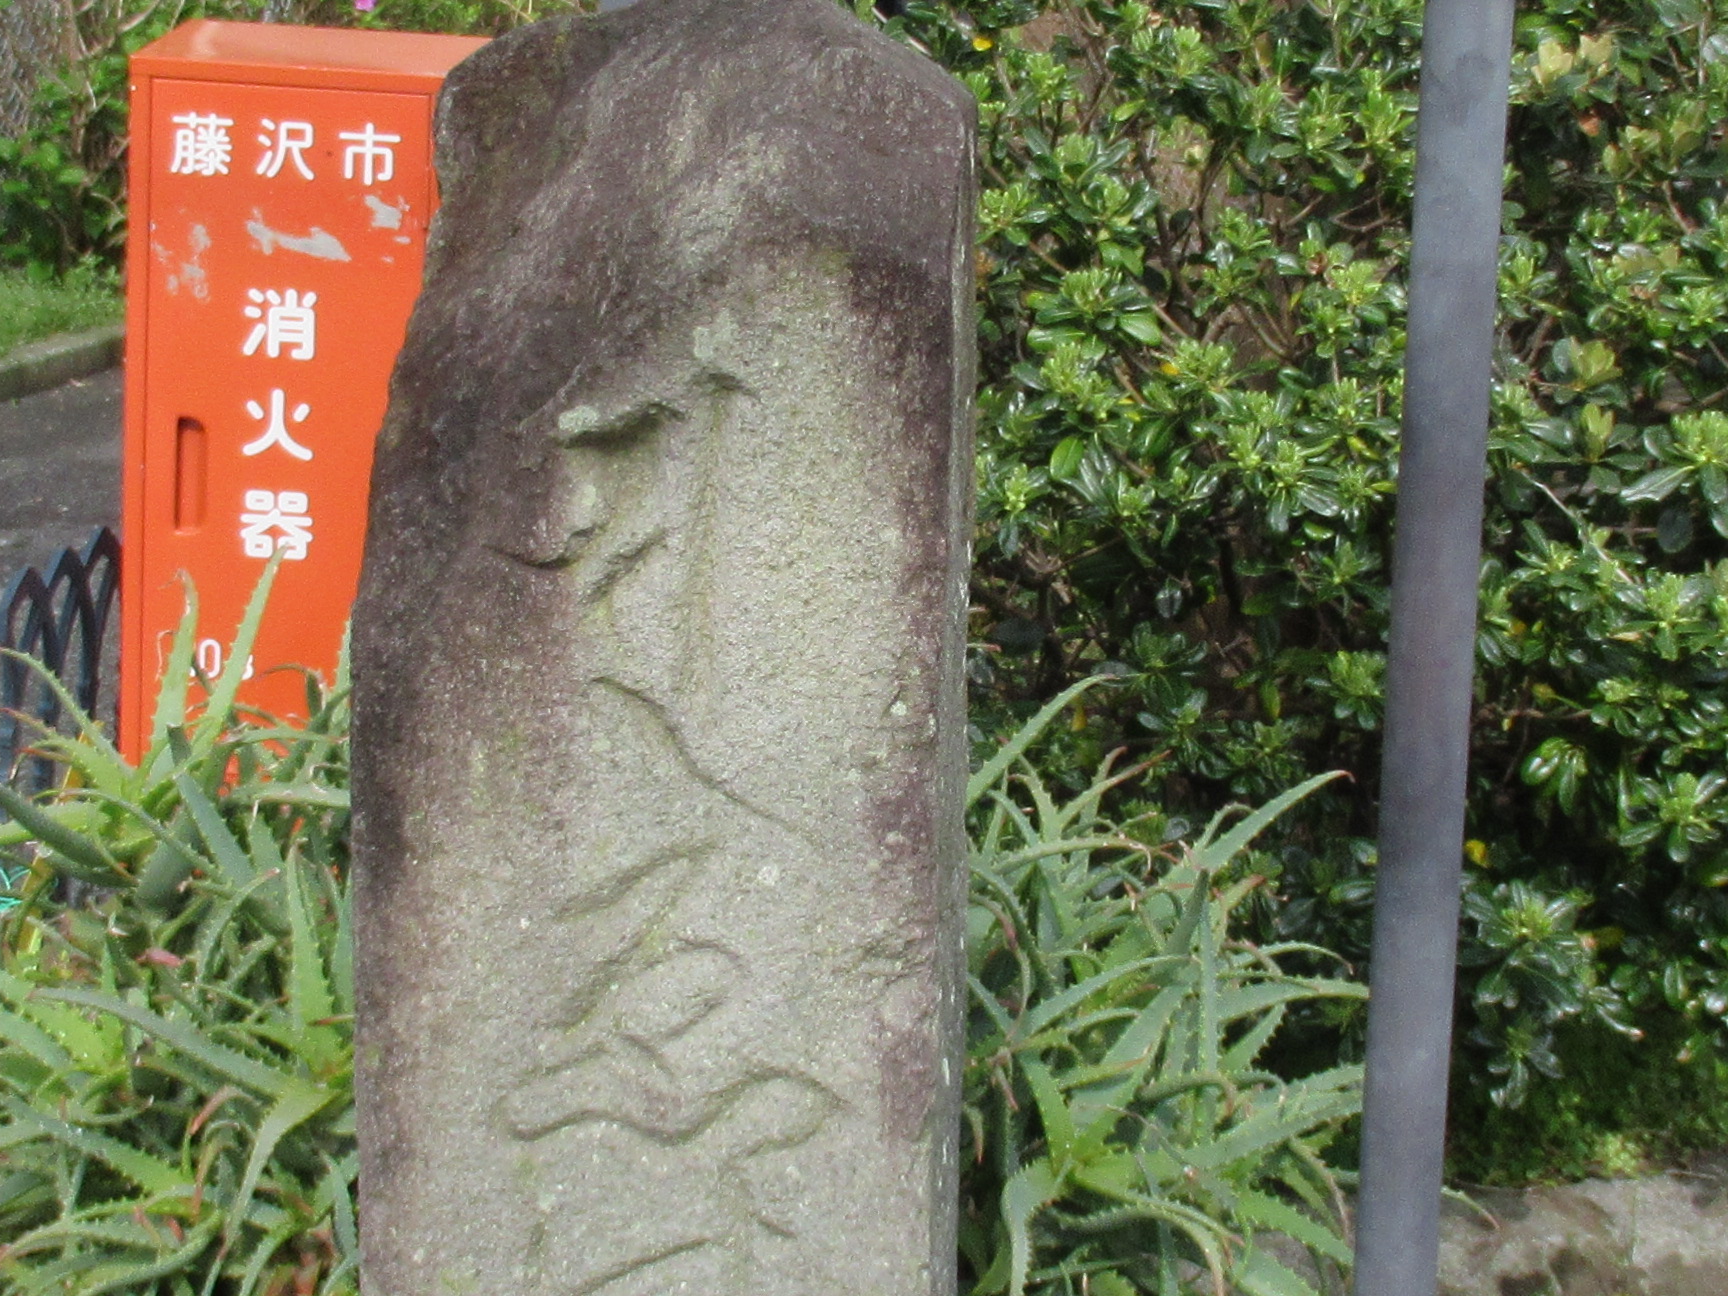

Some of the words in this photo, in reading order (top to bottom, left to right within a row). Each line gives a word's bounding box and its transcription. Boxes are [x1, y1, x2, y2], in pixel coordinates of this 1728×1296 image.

[169, 112, 401, 186] 藤沢市
[239, 289, 318, 561] 消火器
